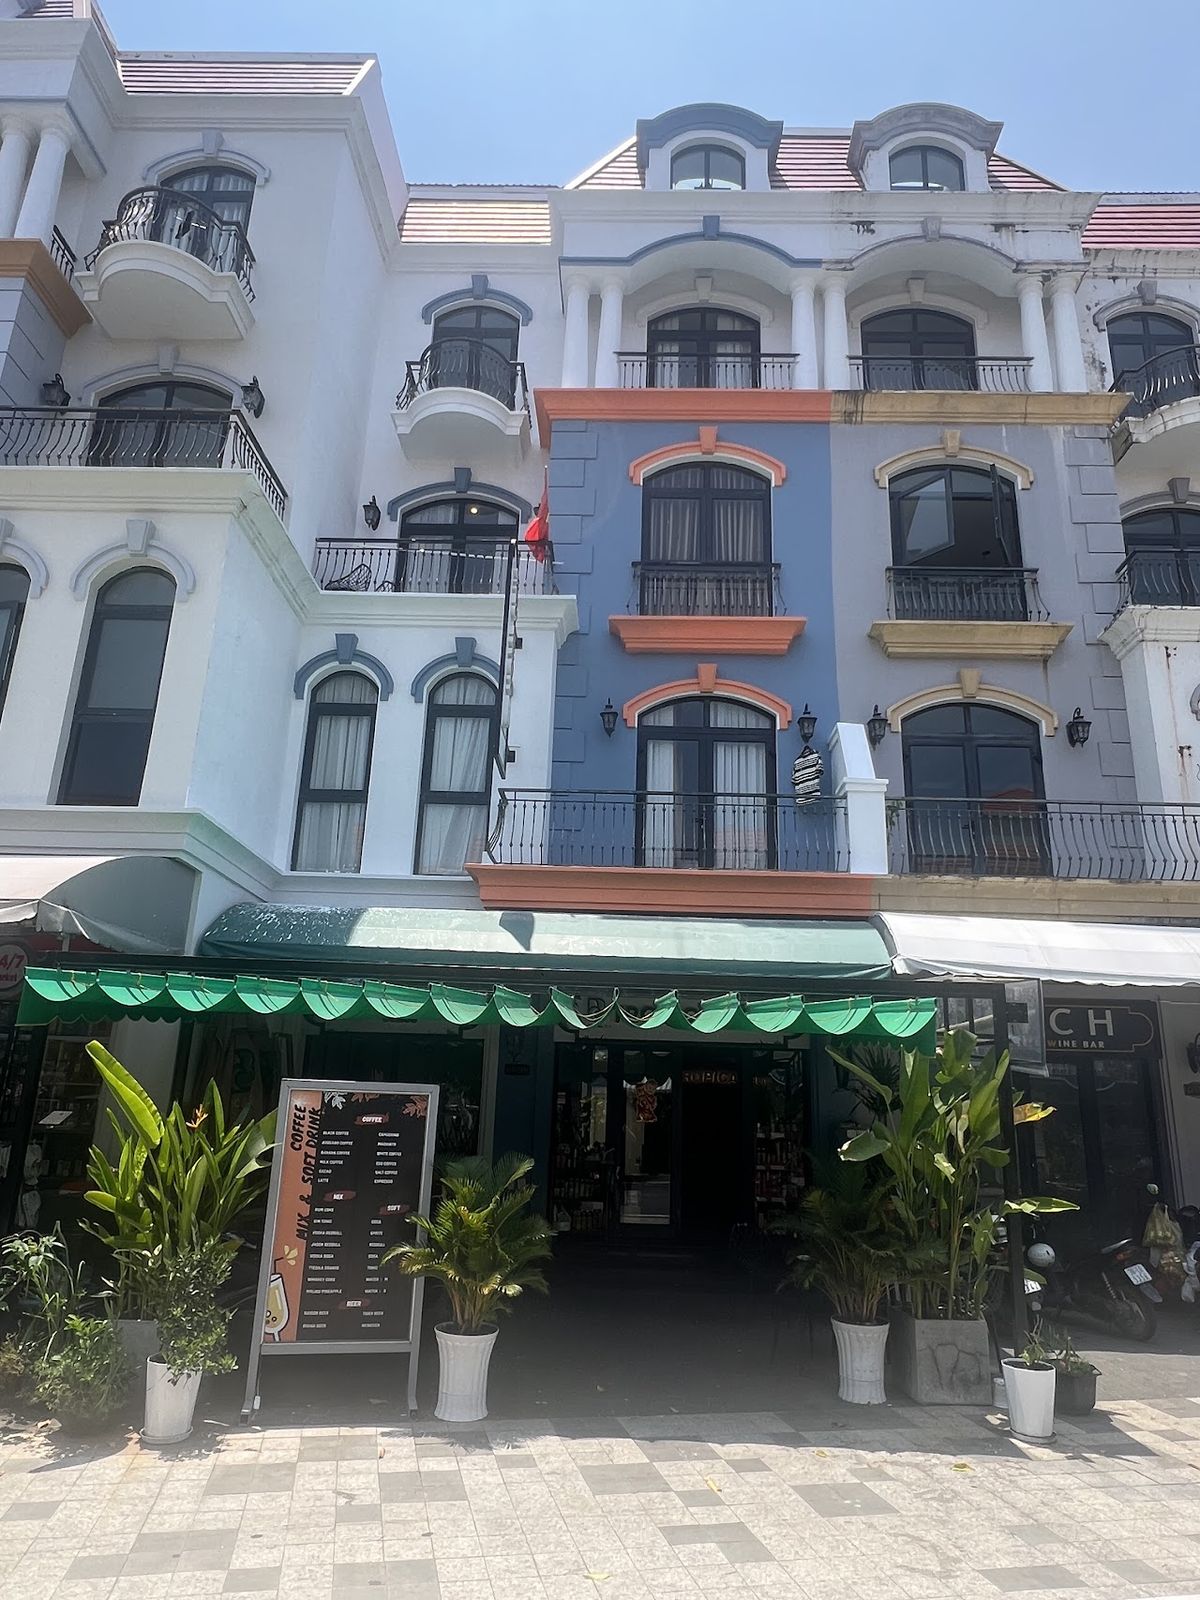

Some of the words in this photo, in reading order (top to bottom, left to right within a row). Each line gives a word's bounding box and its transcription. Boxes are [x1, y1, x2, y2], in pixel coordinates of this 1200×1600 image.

[1047, 1040, 1078, 1048] WINE
[1082, 1040, 1104, 1049] BAR
[290, 1104, 306, 1152] COFFEE
[305, 1107, 321, 1150] DRINK
[301, 1152, 316, 1185] SOFT
[296, 1213, 310, 1241] MIX
